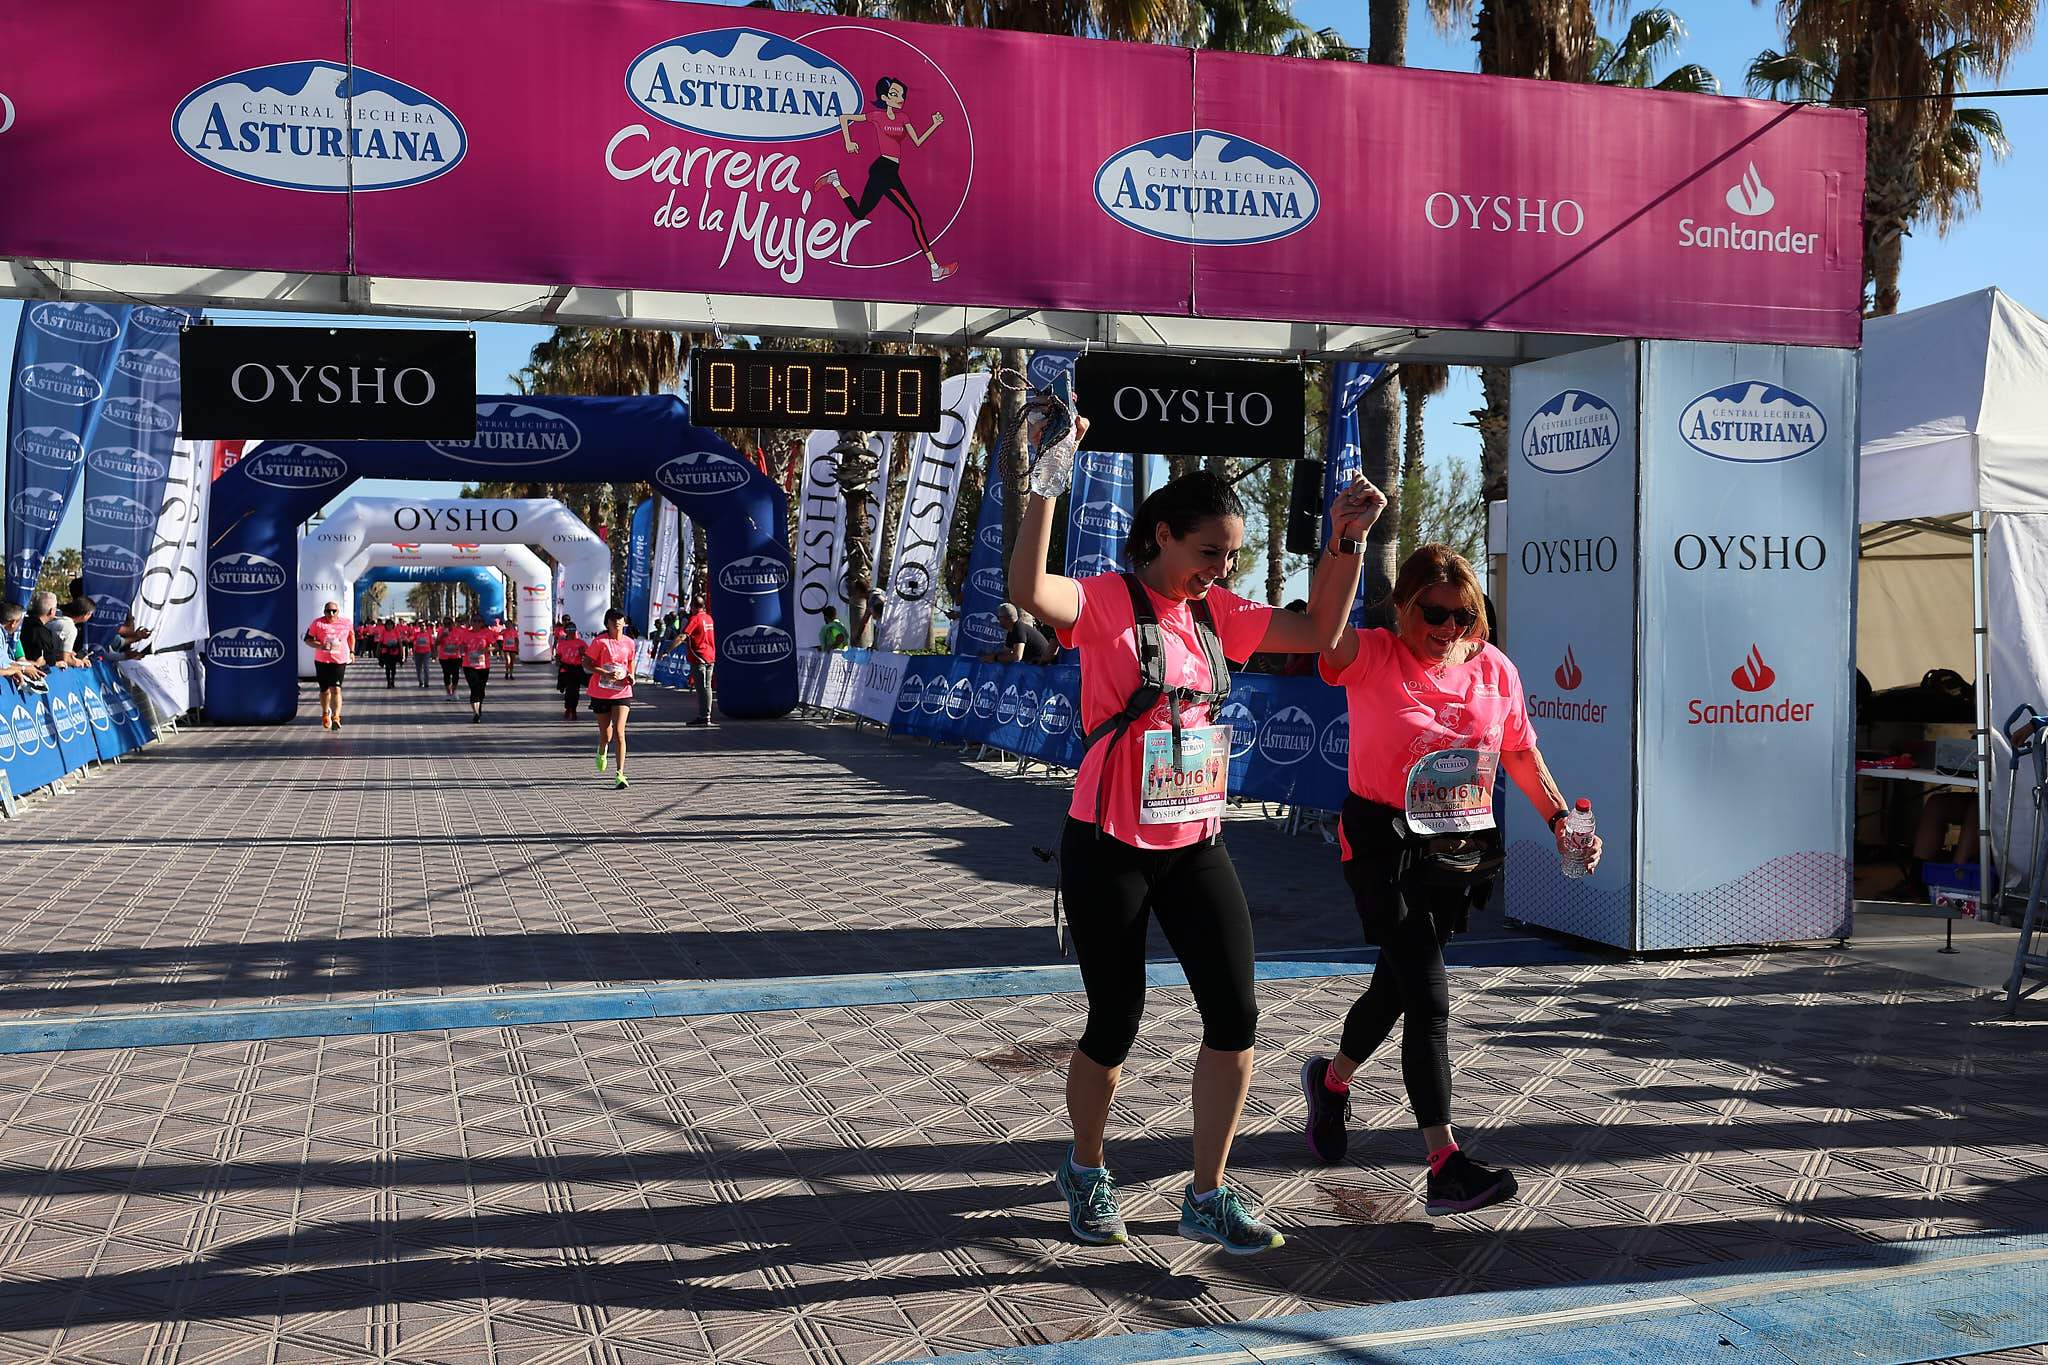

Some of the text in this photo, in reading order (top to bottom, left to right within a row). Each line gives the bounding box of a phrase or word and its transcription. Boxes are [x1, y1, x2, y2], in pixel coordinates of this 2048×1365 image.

[682, 62, 838, 86] CENTRAL LECHERA
[645, 62, 843, 118] ASTURIANA
[242, 101, 336, 119] CENTRAL
[195, 102, 445, 162] ASTURIANA
[605, 124, 801, 194] Carrera
[1147, 166, 1295, 186] CENTRAL LECHERA
[1112, 166, 1303, 219] ASTURIANA
[653, 189, 725, 232] de la
[1424, 191, 1585, 237] OYSHO
[718, 189, 872, 284] Mujer
[1678, 218, 1818, 255] Santander
[36, 308, 112, 338] ASTURIANA
[116, 354, 178, 380] ASTURIANA
[231, 362, 437, 406] OYSHO
[709, 362, 922, 417] 01:03:10
[103, 402, 169, 428] ASTURIANA
[1113, 385, 1274, 428] OYSHO
[1712, 408, 1812, 419] CENTRAL LECHERA
[476, 420, 509, 428] NTRAL
[1541, 413, 1609, 431] CENTRAL LECHERA
[1690, 409, 1815, 443] ASTURIANA
[1527, 425, 1612, 457] ASTURIANA
[92, 454, 158, 477] ASTURIANA
[251, 459, 339, 478] ASTURIANA
[663, 468, 745, 485] ASTURIANA
[85, 503, 149, 526] ASTURIANA
[895, 409, 967, 602] OYSHO
[394, 507, 519, 532] OYSHO
[318, 533, 357, 542] OYSHO
[800, 454, 841, 615] OYSHO
[1522, 536, 1618, 575] OYSHO
[1673, 533, 1827, 571] OYSHO
[210, 567, 281, 585] ASTURIANA
[300, 583, 337, 592] OYSHO
[571, 583, 606, 592] OYSHO
[724, 571, 786, 586] ASTURIANA
[209, 641, 280, 658] ASTURIANA
[727, 640, 790, 656] ASTURIANA
[1528, 694, 1608, 724] Santander
[1687, 698, 1814, 725] Santander
[1262, 726, 1310, 750] ASTURIANA
[1436, 785, 1468, 800] 016
